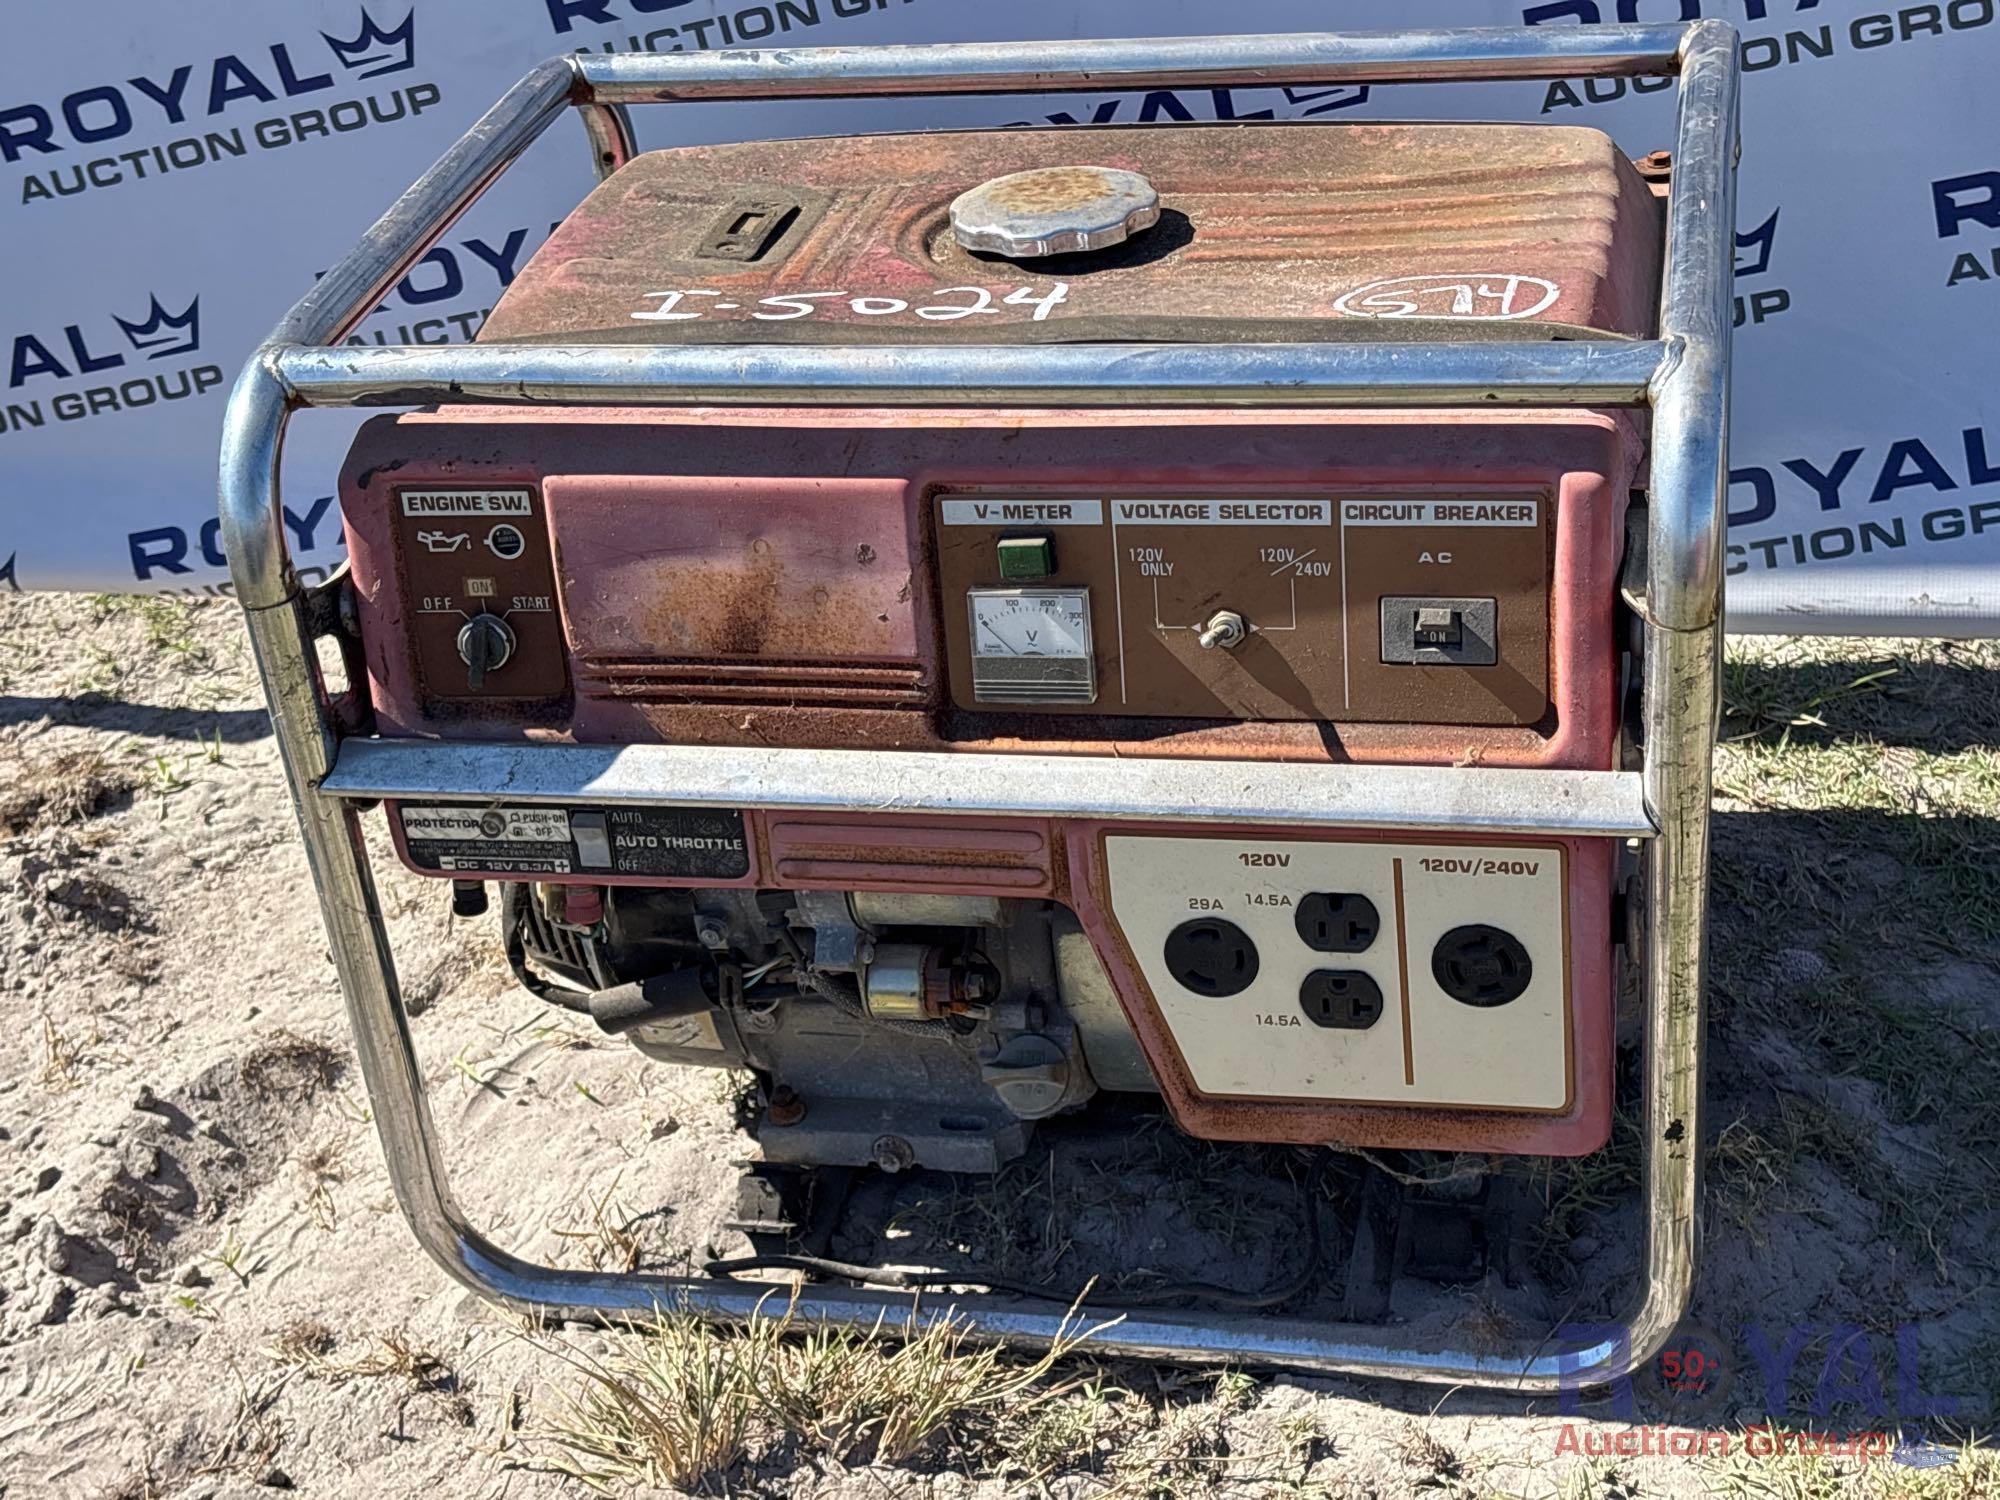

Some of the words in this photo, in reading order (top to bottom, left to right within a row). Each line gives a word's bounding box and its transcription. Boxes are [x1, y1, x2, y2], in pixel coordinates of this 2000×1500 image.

[0, 43, 335, 163] ROYAL
[22, 128, 247, 204] AUCTION
[254, 83, 441, 149] GROUP
[630, 282, 1069, 320] I-5024
[52, 364, 223, 421] GROUP
[1727, 427, 2000, 528] OYAL
[408, 495, 483, 512] ENGINE
[488, 496, 527, 511] SW.
[974, 504, 1073, 520] V-METER
[1120, 504, 1210, 519] VOLTAGE
[1219, 504, 1323, 520] SELECTOR
[1345, 504, 1425, 520] CIRCUIT
[1434, 505, 1533, 521] BREAKER
[1726, 517, 1907, 576] CTION
[1128, 548, 1164, 562] 120V
[1418, 552, 1453, 564] AC
[1140, 562, 1174, 577] ONLY
[471, 581, 490, 594] ON
[423, 597, 453, 610] OFF
[512, 596, 550, 609] START
[978, 613, 984, 621] 0
[1026, 630, 1038, 642] V
[1429, 631, 1446, 643] ON
[405, 818, 481, 829] PROTECTOR
[611, 812, 642, 824] AUTO
[536, 827, 553, 837] OFF
[615, 835, 658, 848] AUTO
[662, 836, 743, 850] THROTTLE
[457, 860, 479, 870] DC
[486, 861, 513, 871] 12V
[618, 859, 639, 871] OFF
[1238, 853, 1291, 867] 120V
[1419, 858, 1540, 876] 120V/240V
[1188, 898, 1224, 910] 29A
[1245, 893, 1293, 907] 14.5A
[1255, 1013, 1302, 1028] 14.5A
